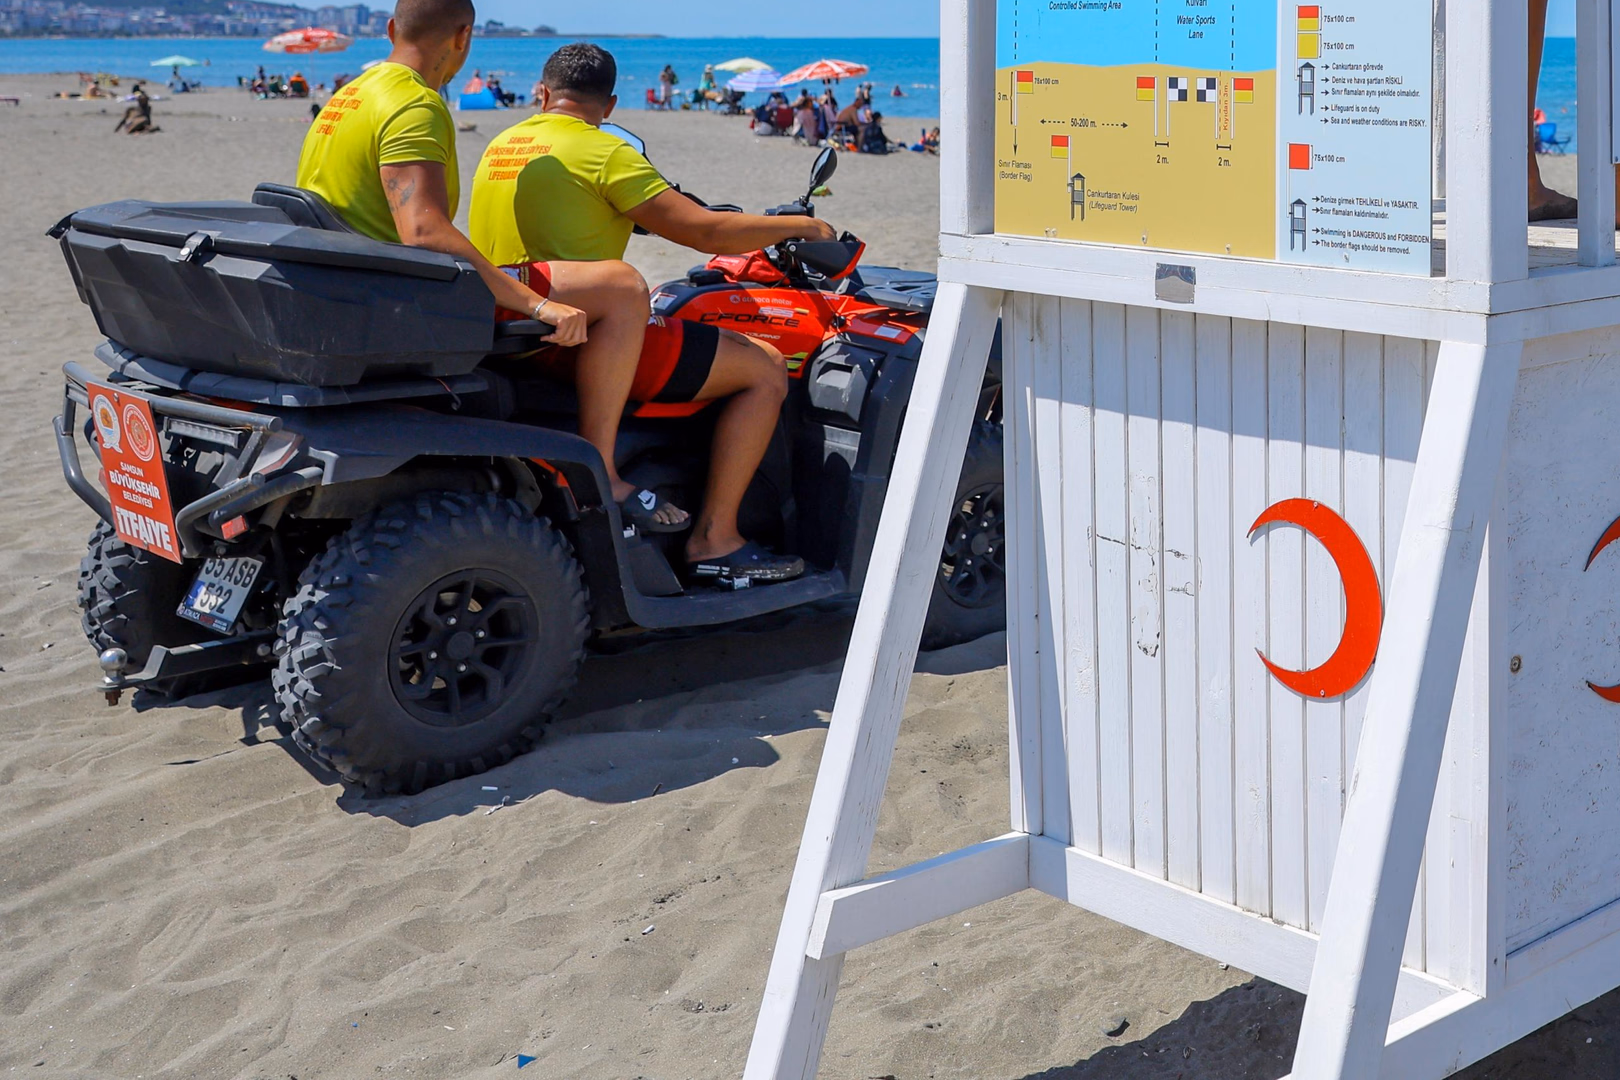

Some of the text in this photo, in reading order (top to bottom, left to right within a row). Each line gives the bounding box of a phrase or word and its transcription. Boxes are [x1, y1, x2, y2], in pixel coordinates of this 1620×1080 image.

[1049, 0, 1122, 11] Controlled Swimming Area
[1177, 14, 1216, 26] Water Sports
[1323, 15, 1344, 23] 75x100
[1188, 29, 1204, 39] Lane
[1323, 42, 1344, 50] 75x100
[1331, 62, 1362, 71] Cankurtaran
[1353, 76, 1366, 84] hava
[997, 91, 1002, 101] 3
[1330, 104, 1355, 113] Lifeguard
[1368, 105, 1380, 115] duty
[1070, 117, 1097, 128] 50-200 m.
[1330, 116, 1340, 124] Sea
[1341, 117, 1351, 125] and
[1371, 118, 1399, 126] conditions
[1156, 154, 1169, 164] 2 m.
[1218, 157, 1231, 167] 2 m.
[1314, 154, 1335, 162] 75x100
[1086, 189, 1140, 200] Cankurtaran Kulesi
[1320, 195, 1337, 204] Denize
[1337, 196, 1355, 206] girmek
[1119, 202, 1138, 213] Tower)
[1320, 227, 1346, 238] Swimming
[1352, 229, 1386, 240] DANGEROUS
[1387, 233, 1397, 241] and
[1320, 239, 1330, 247] The
[1331, 240, 1348, 249] border
[1348, 241, 1361, 251] flags
[1361, 242, 1379, 252] should
[1379, 244, 1386, 252] be
[700, 312, 800, 328] CFORCE
[120, 461, 144, 477] SAMSUN
[109, 469, 161, 500] BÜYÜKŞEHİR
[122, 490, 153, 509] BELEDİYESİ
[223, 558, 257, 588] ASB
[200, 582, 233, 614] 532
